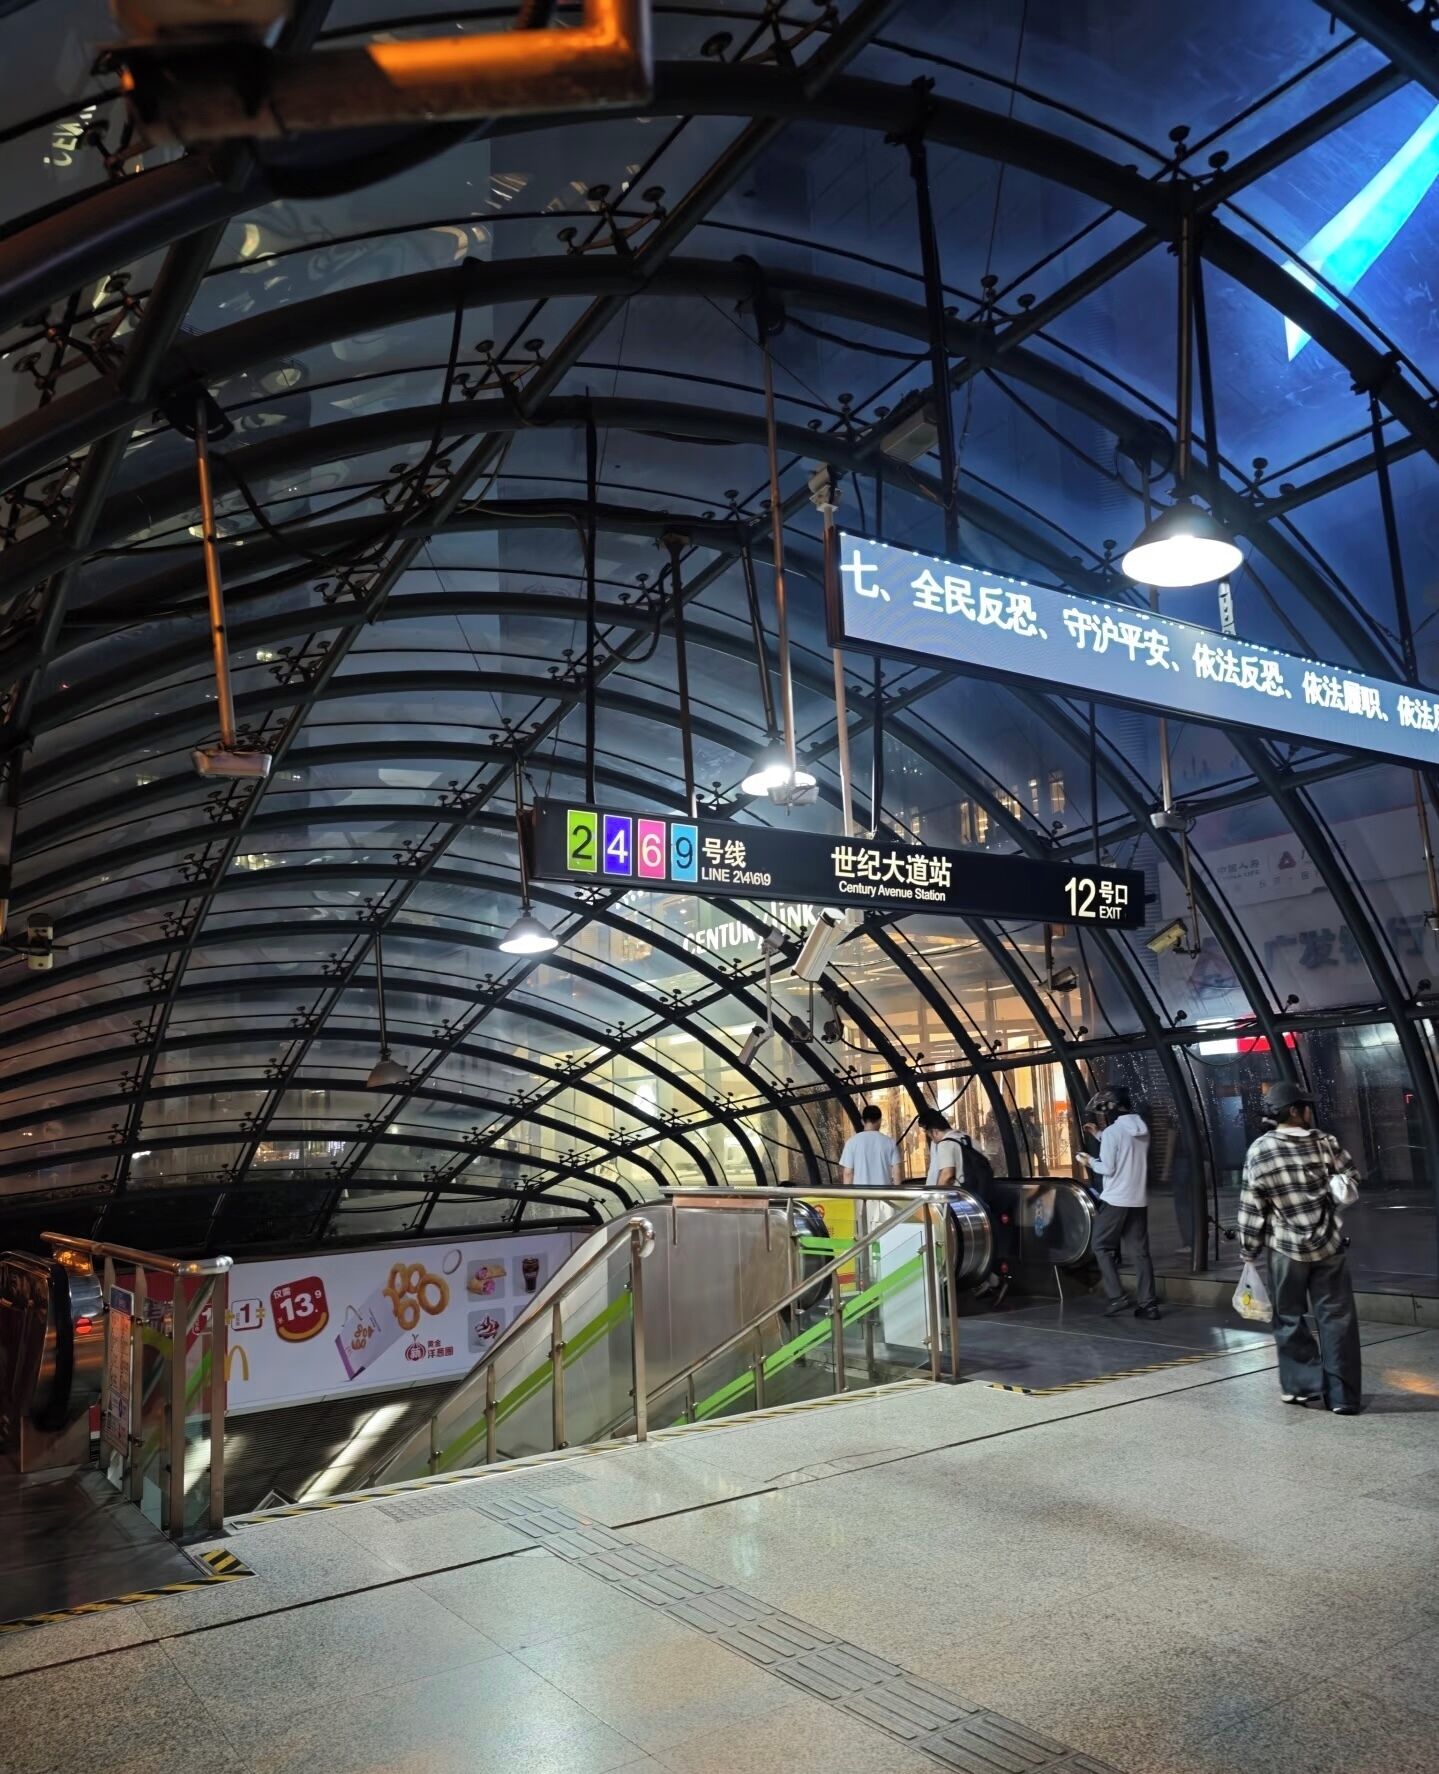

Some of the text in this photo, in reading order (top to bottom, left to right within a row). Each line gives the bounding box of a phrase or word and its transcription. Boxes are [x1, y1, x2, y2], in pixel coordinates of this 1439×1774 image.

[572, 825, 746, 869] 2 4 6 9 号线
[701, 867, 730, 882] LINE
[831, 845, 952, 887] 世纪大道站
[838, 880, 945, 901] Century Avenue Station
[1099, 905, 1122, 919] EXIT
[240, 1303, 250, 1323] 1
